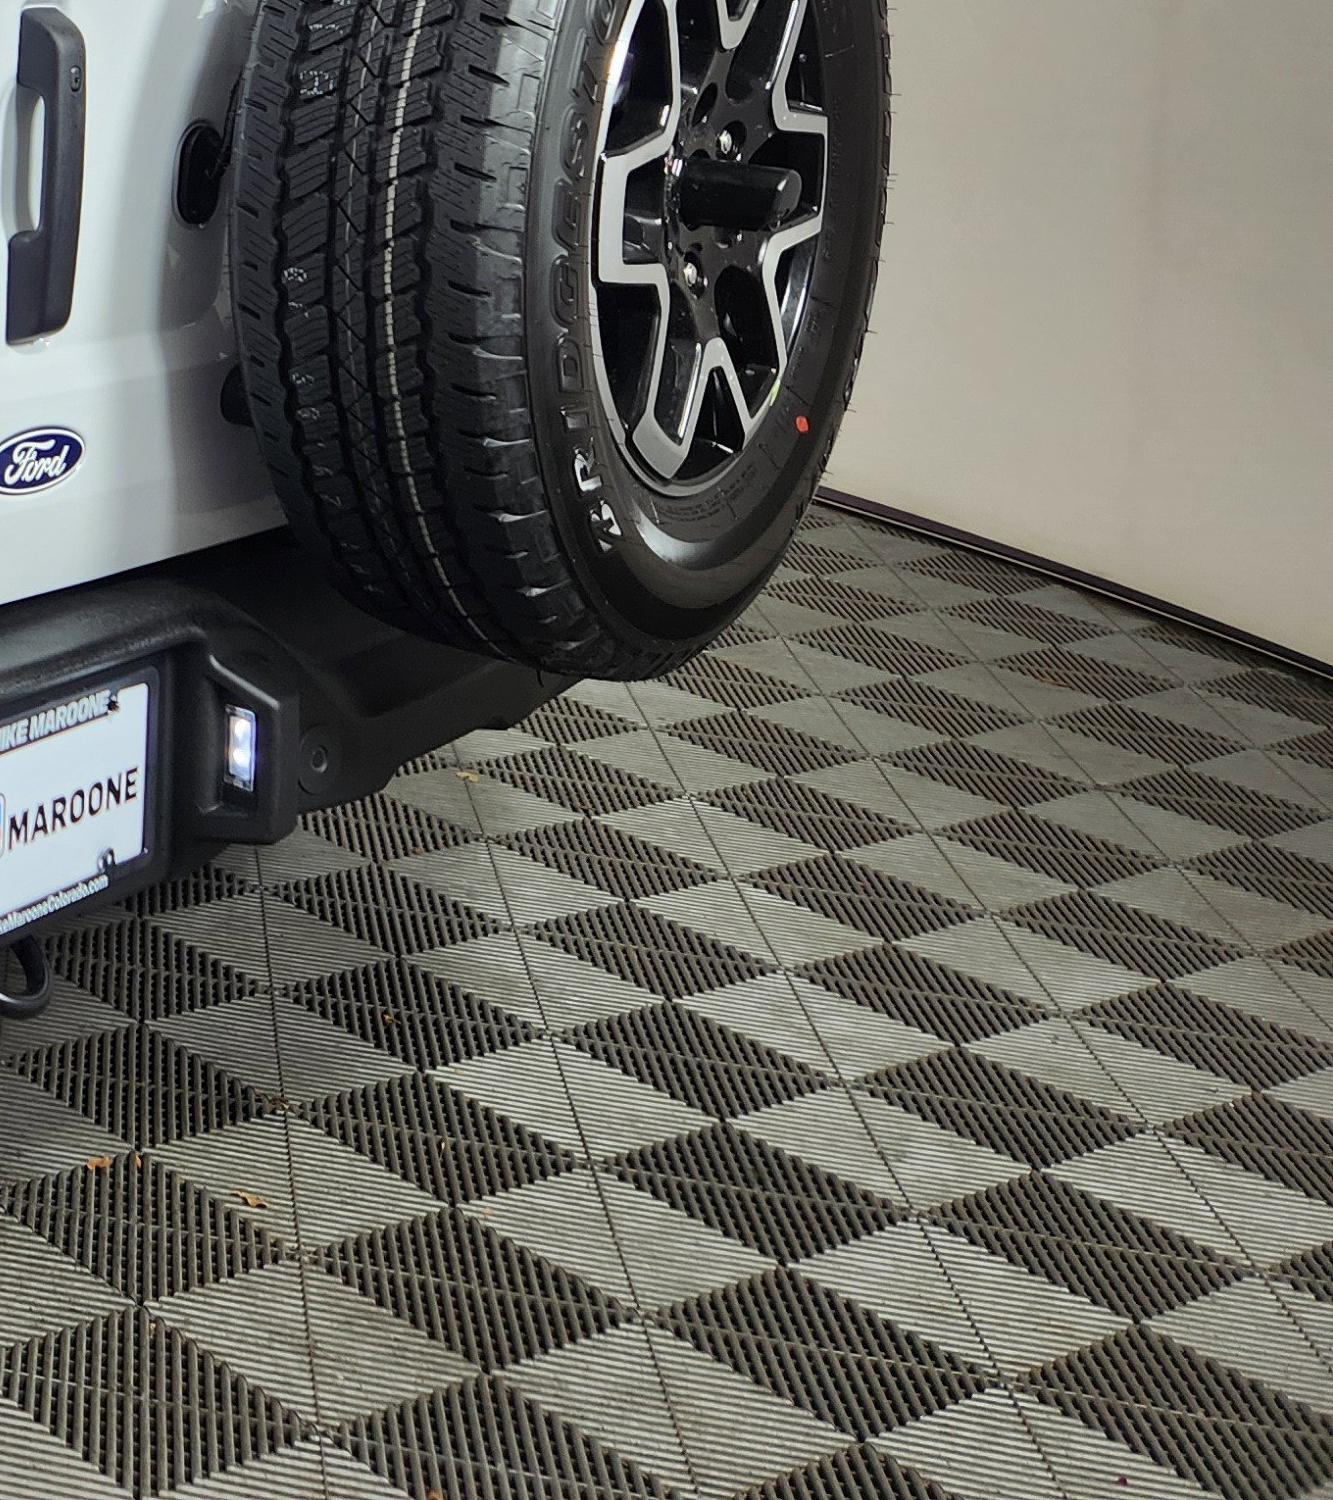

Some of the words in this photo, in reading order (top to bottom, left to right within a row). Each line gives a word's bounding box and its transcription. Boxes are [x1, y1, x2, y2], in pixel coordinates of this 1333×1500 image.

[4, 438, 70, 486] Ford
[28, 689, 111, 741] MAROONE
[8, 766, 139, 851] MAROONE
